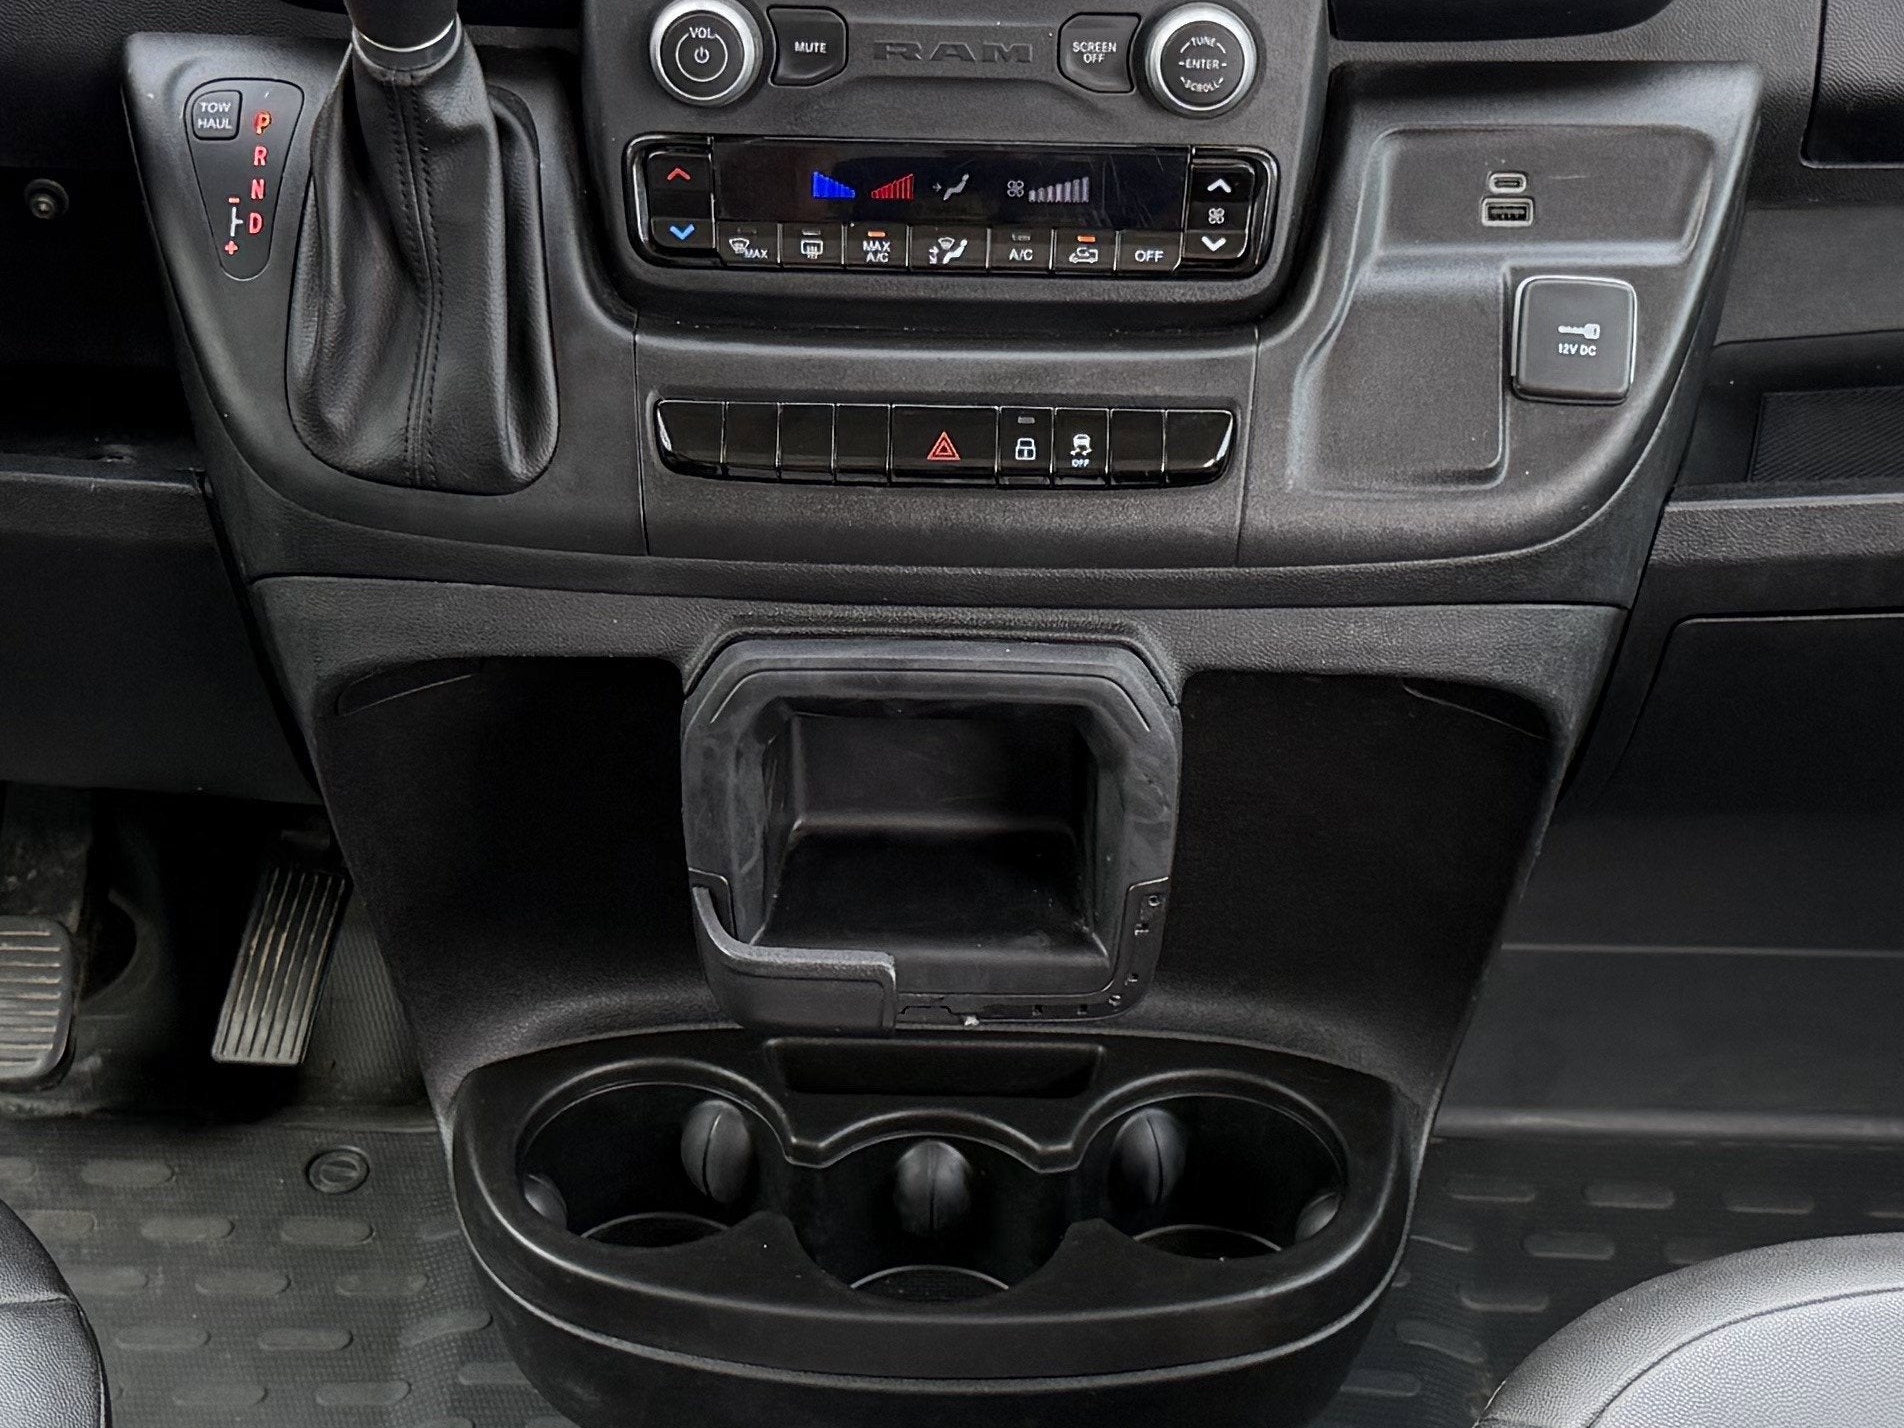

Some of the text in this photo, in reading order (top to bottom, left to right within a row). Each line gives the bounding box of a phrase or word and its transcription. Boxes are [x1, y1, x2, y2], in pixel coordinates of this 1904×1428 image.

[689, 27, 716, 39] VOL
[794, 42, 827, 54] MUTE
[1072, 41, 1117, 53] SCREEN
[1190, 36, 1217, 48] TUNE
[873, 40, 1033, 63] RAM
[1083, 53, 1106, 64] OFF
[1185, 59, 1220, 70] ENTER
[1183, 79, 1220, 94] SCROLL
[200, 101, 232, 114] TOW
[197, 118, 232, 130] HAUL
[255, 110, 273, 135] P
[253, 146, 269, 166] R
[251, 178, 266, 200] N
[249, 212, 263, 234] D
[863, 240, 891, 252] MAX
[744, 249, 768, 260] MAX
[866, 252, 889, 263] A/C
[1009, 248, 1033, 261] A/C
[1134, 249, 1164, 263] OFF
[1558, 343, 1597, 356] 12V DC
[1071, 458, 1090, 468] OFF
